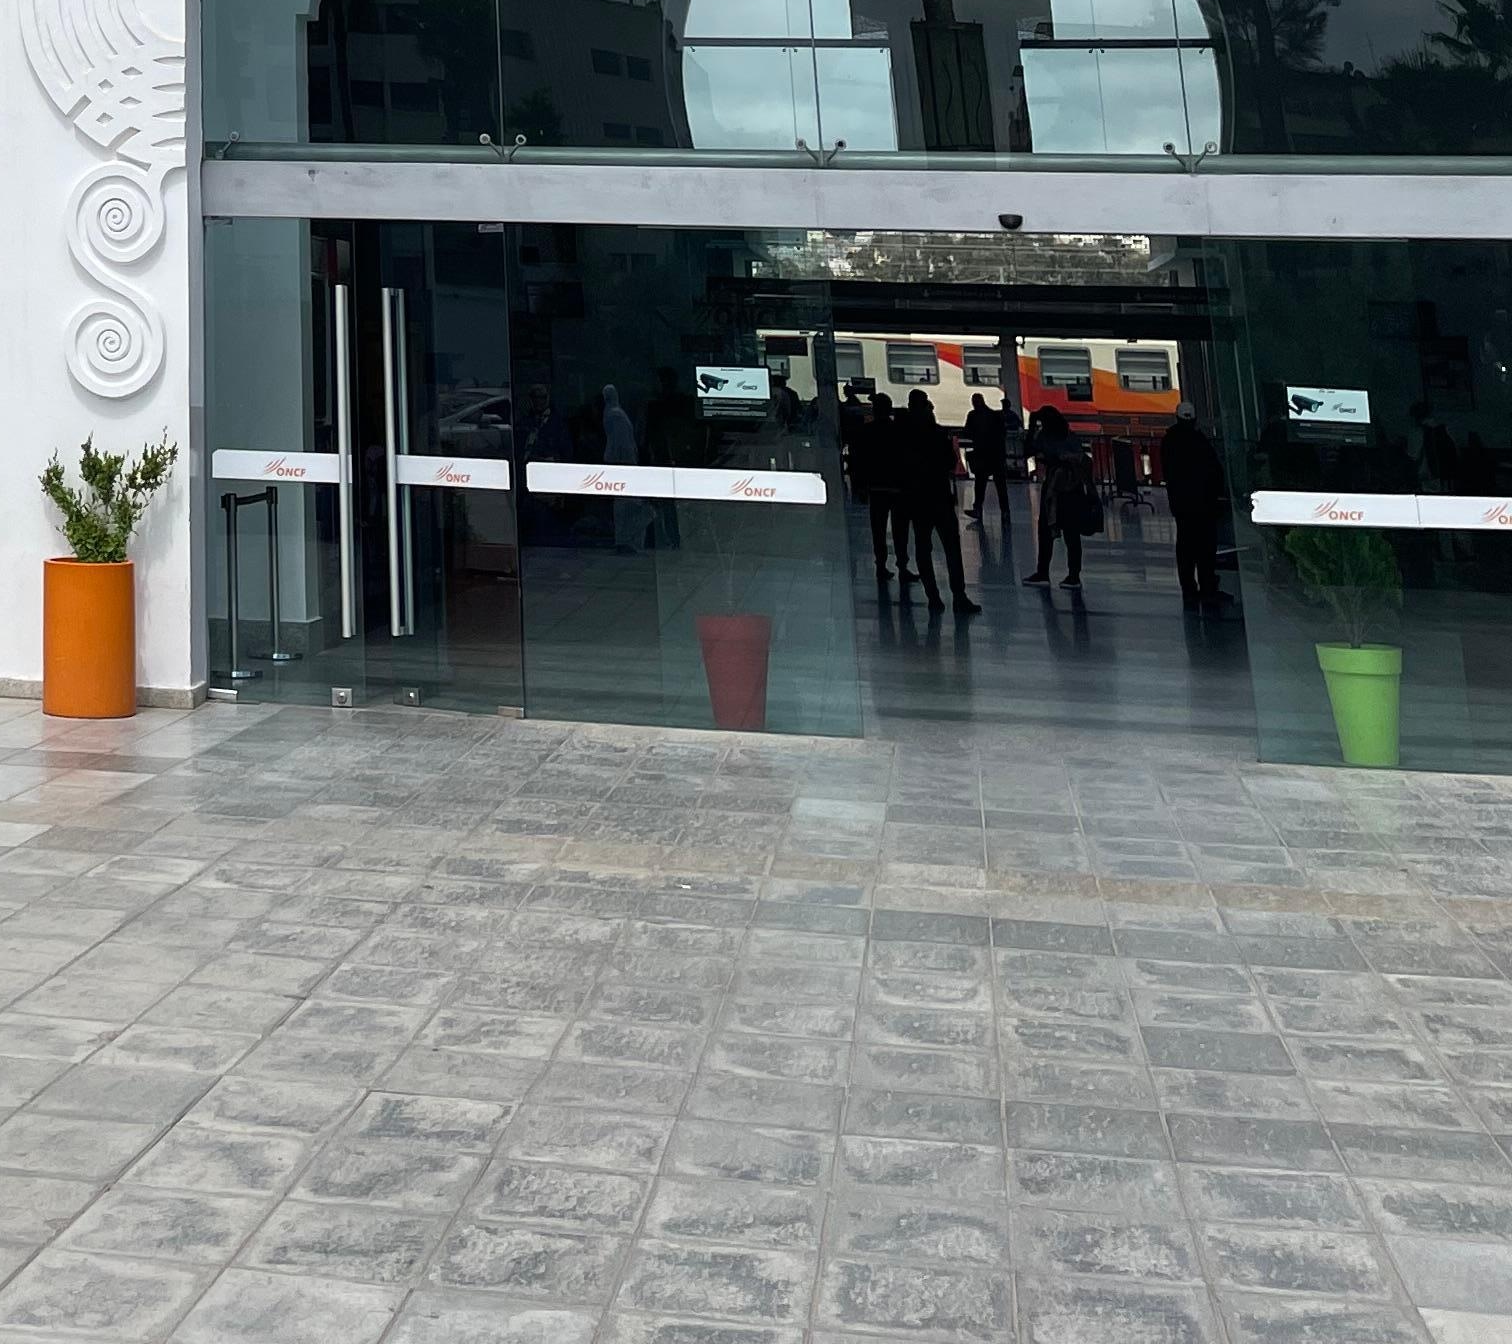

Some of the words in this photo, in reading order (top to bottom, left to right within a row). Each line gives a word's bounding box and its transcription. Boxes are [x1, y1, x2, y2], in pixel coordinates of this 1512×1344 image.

[276, 467, 306, 478] ONCF
[446, 473, 472, 483] ONCF
[594, 481, 626, 492] ONCF
[743, 487, 777, 498] ONCF
[1328, 510, 1364, 521] ONCF
